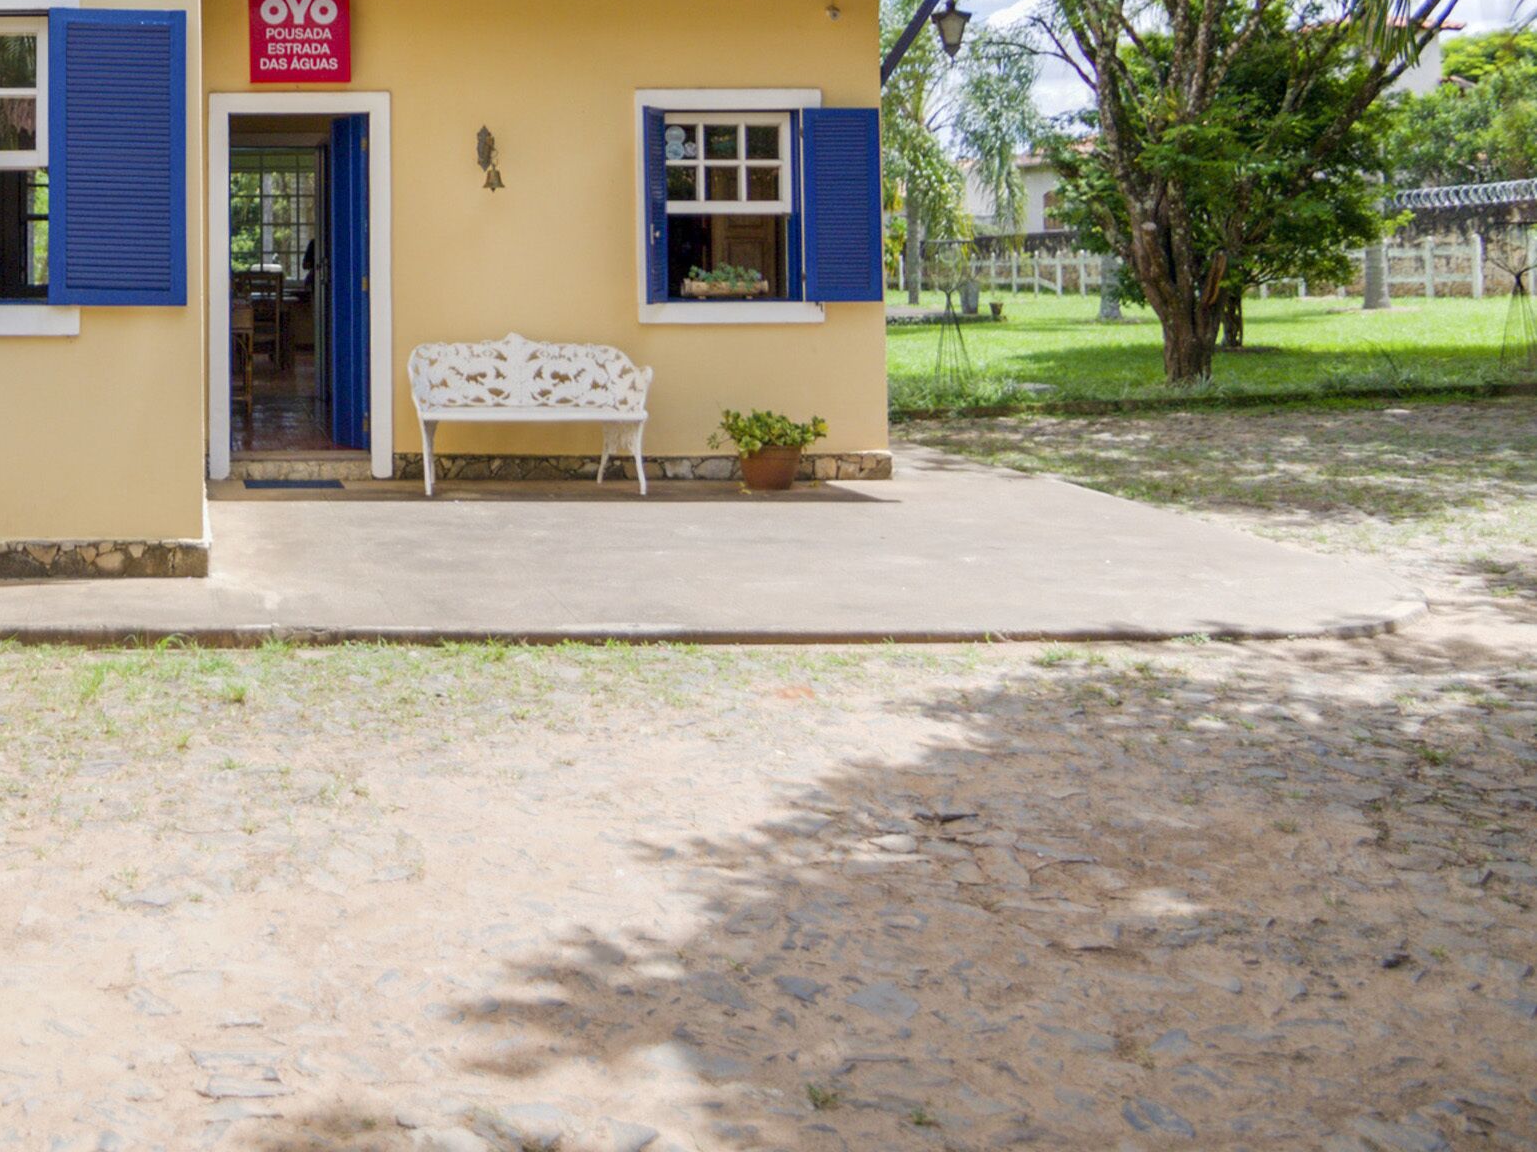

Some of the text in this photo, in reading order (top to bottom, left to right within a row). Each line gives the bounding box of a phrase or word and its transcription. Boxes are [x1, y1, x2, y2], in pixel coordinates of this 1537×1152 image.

[265, 28, 332, 40] POUSADA
[267, 43, 331, 55] ESTRADA
[260, 55, 338, 70] DAS ÁGUAS
